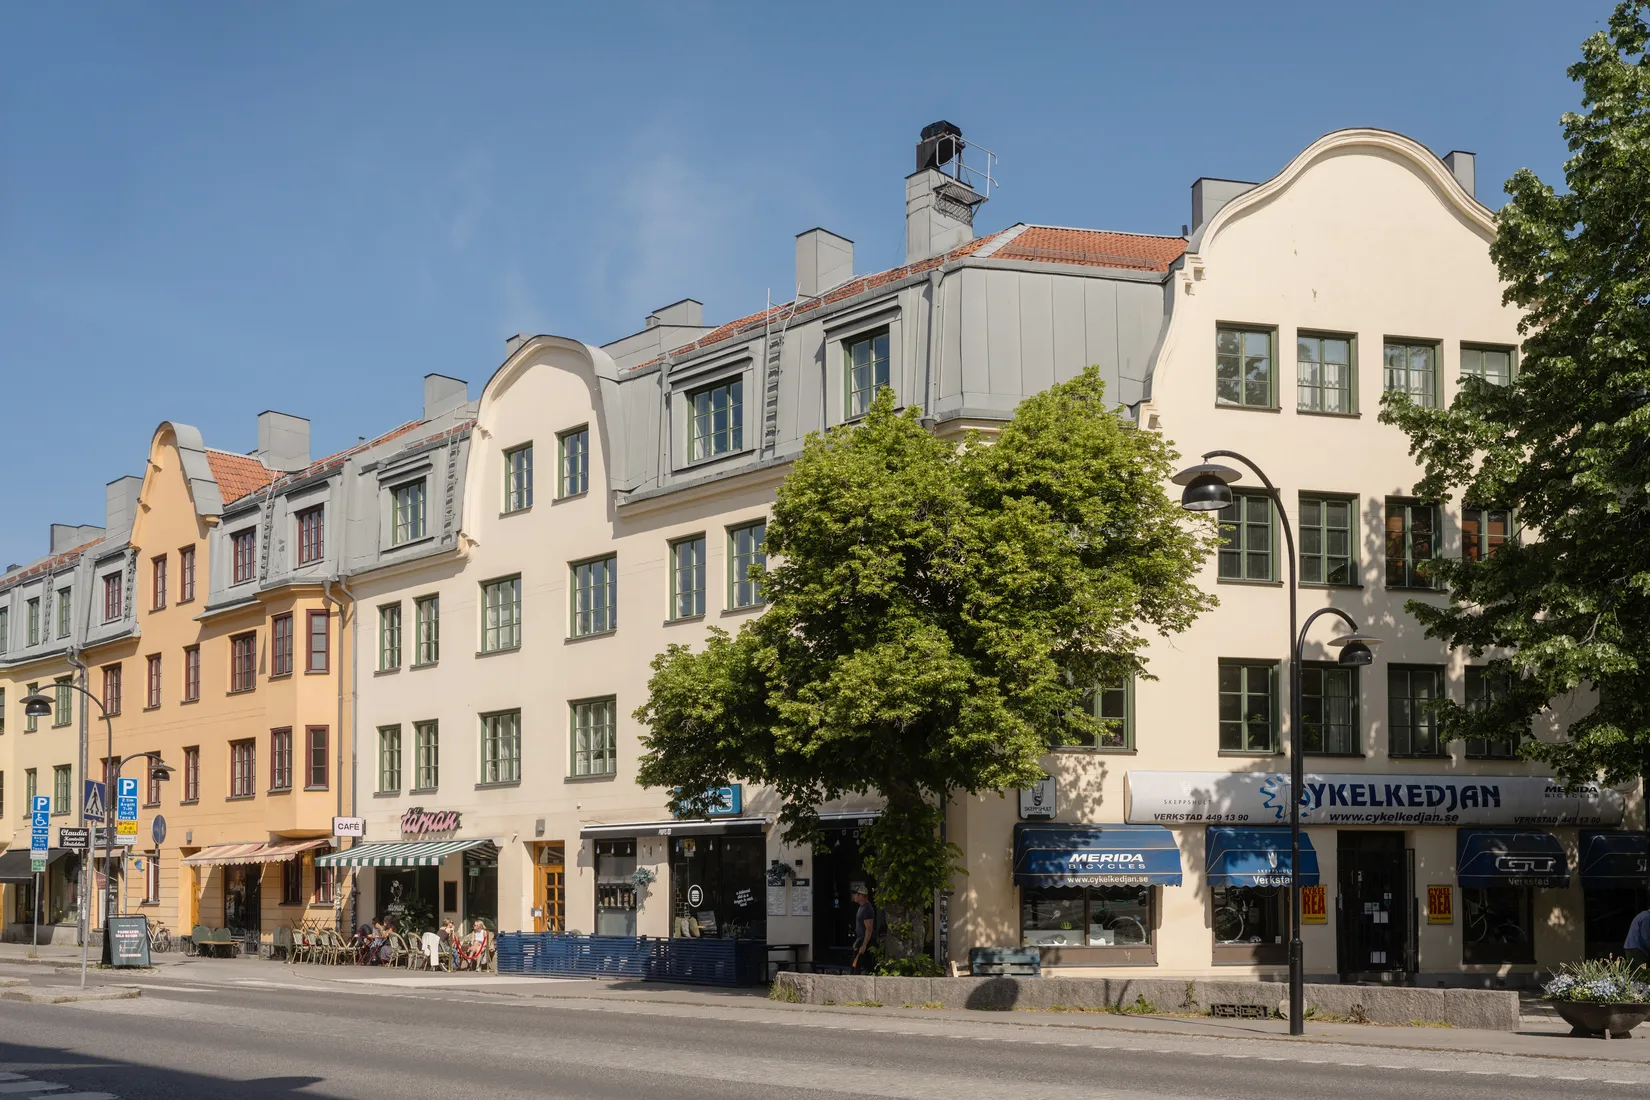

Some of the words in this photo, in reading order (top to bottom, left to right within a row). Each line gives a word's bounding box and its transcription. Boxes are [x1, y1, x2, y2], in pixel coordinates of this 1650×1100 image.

[123, 780, 134, 795] P
[37, 797, 48, 810] P
[1154, 813, 1203, 821] VERKSTAD
[1329, 812, 1459, 823] www.cykelkedjan.se
[1513, 816, 1558, 824] VERKSTAD
[1591, 816, 1600, 824] 90
[337, 822, 360, 831] CAFÉ
[60, 828, 88, 837] Claudia
[1068, 853, 1144, 862] MERIDA
[1067, 875, 1149, 884] www.cykelkedjan.se
[1253, 875, 1292, 885] Verksta
[1508, 877, 1549, 885] Verkstad
[1302, 886, 1325, 895] CYKEL
[1428, 887, 1451, 896] CYKEL
[1303, 894, 1326, 915] REA
[1429, 895, 1451, 915] REA
